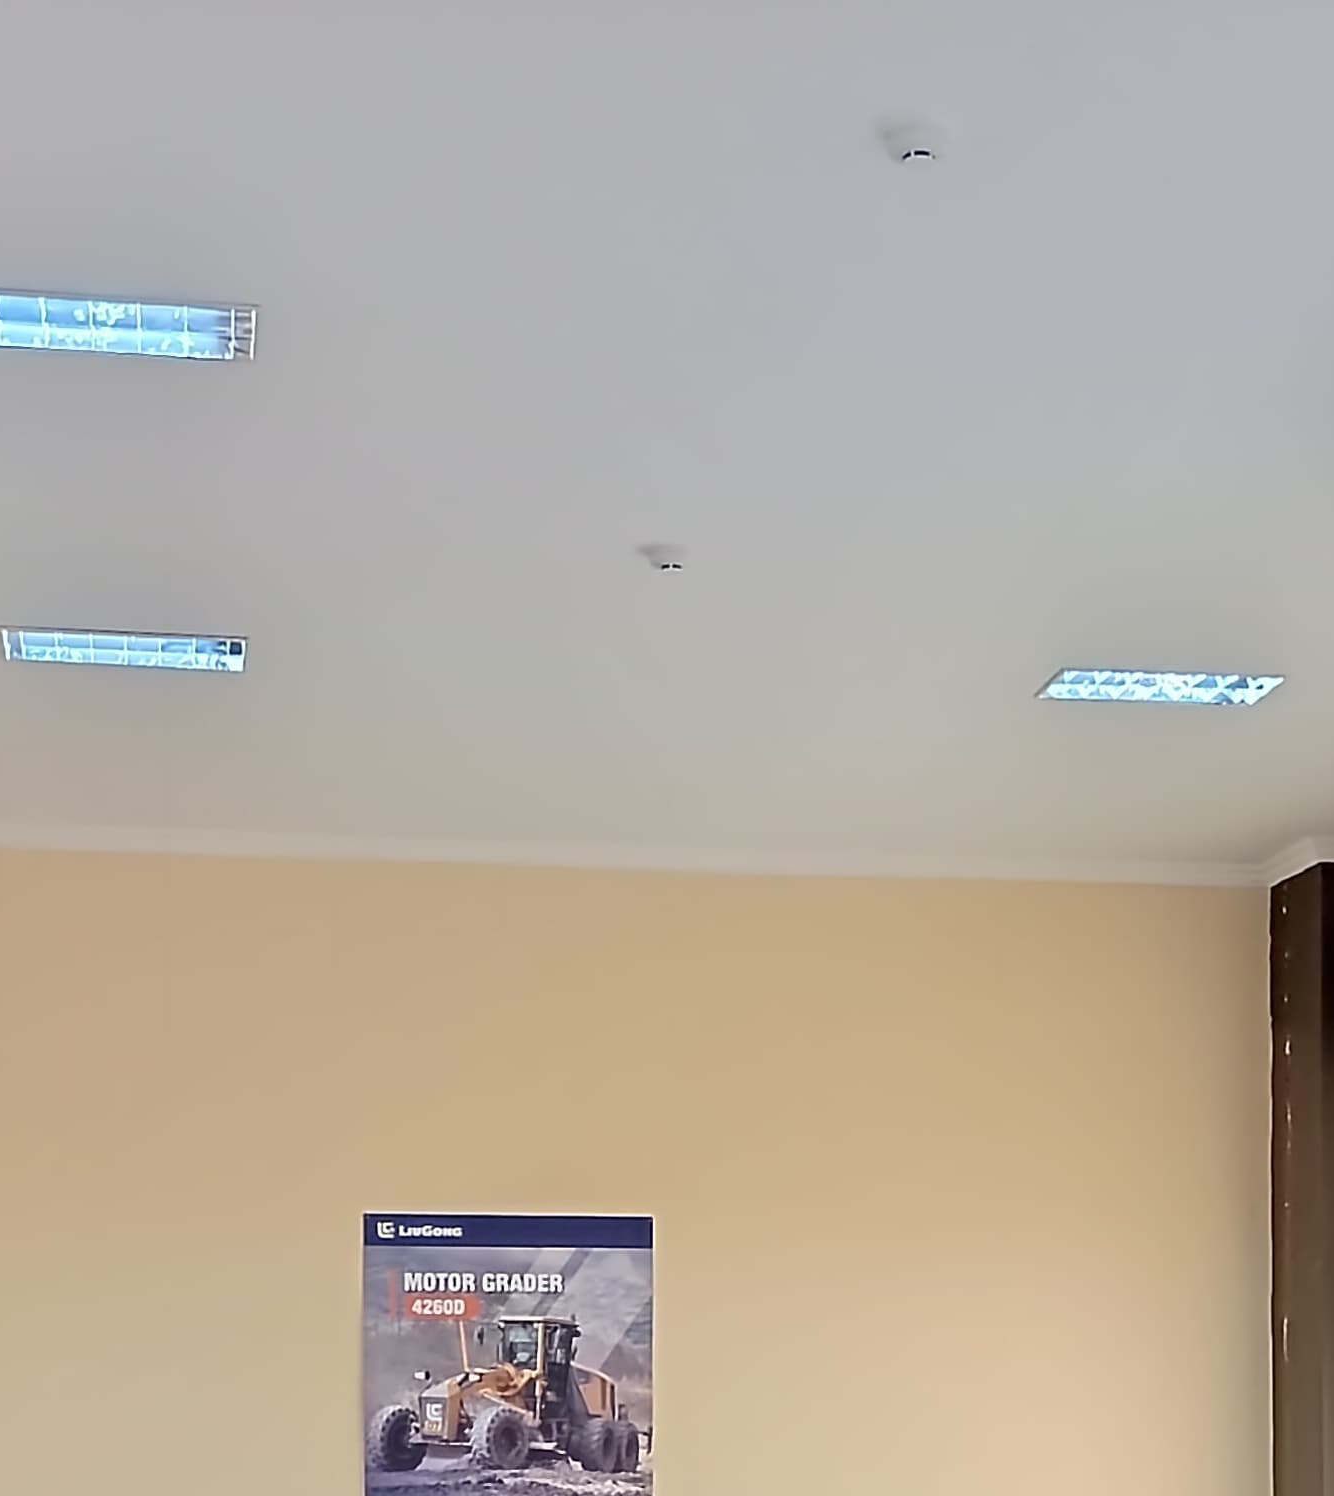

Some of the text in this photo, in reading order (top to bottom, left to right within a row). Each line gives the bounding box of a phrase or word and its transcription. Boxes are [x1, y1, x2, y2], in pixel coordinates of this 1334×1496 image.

[404, 1272, 564, 1293] MOTOR GRADER
[411, 1298, 465, 1315] 4260D
